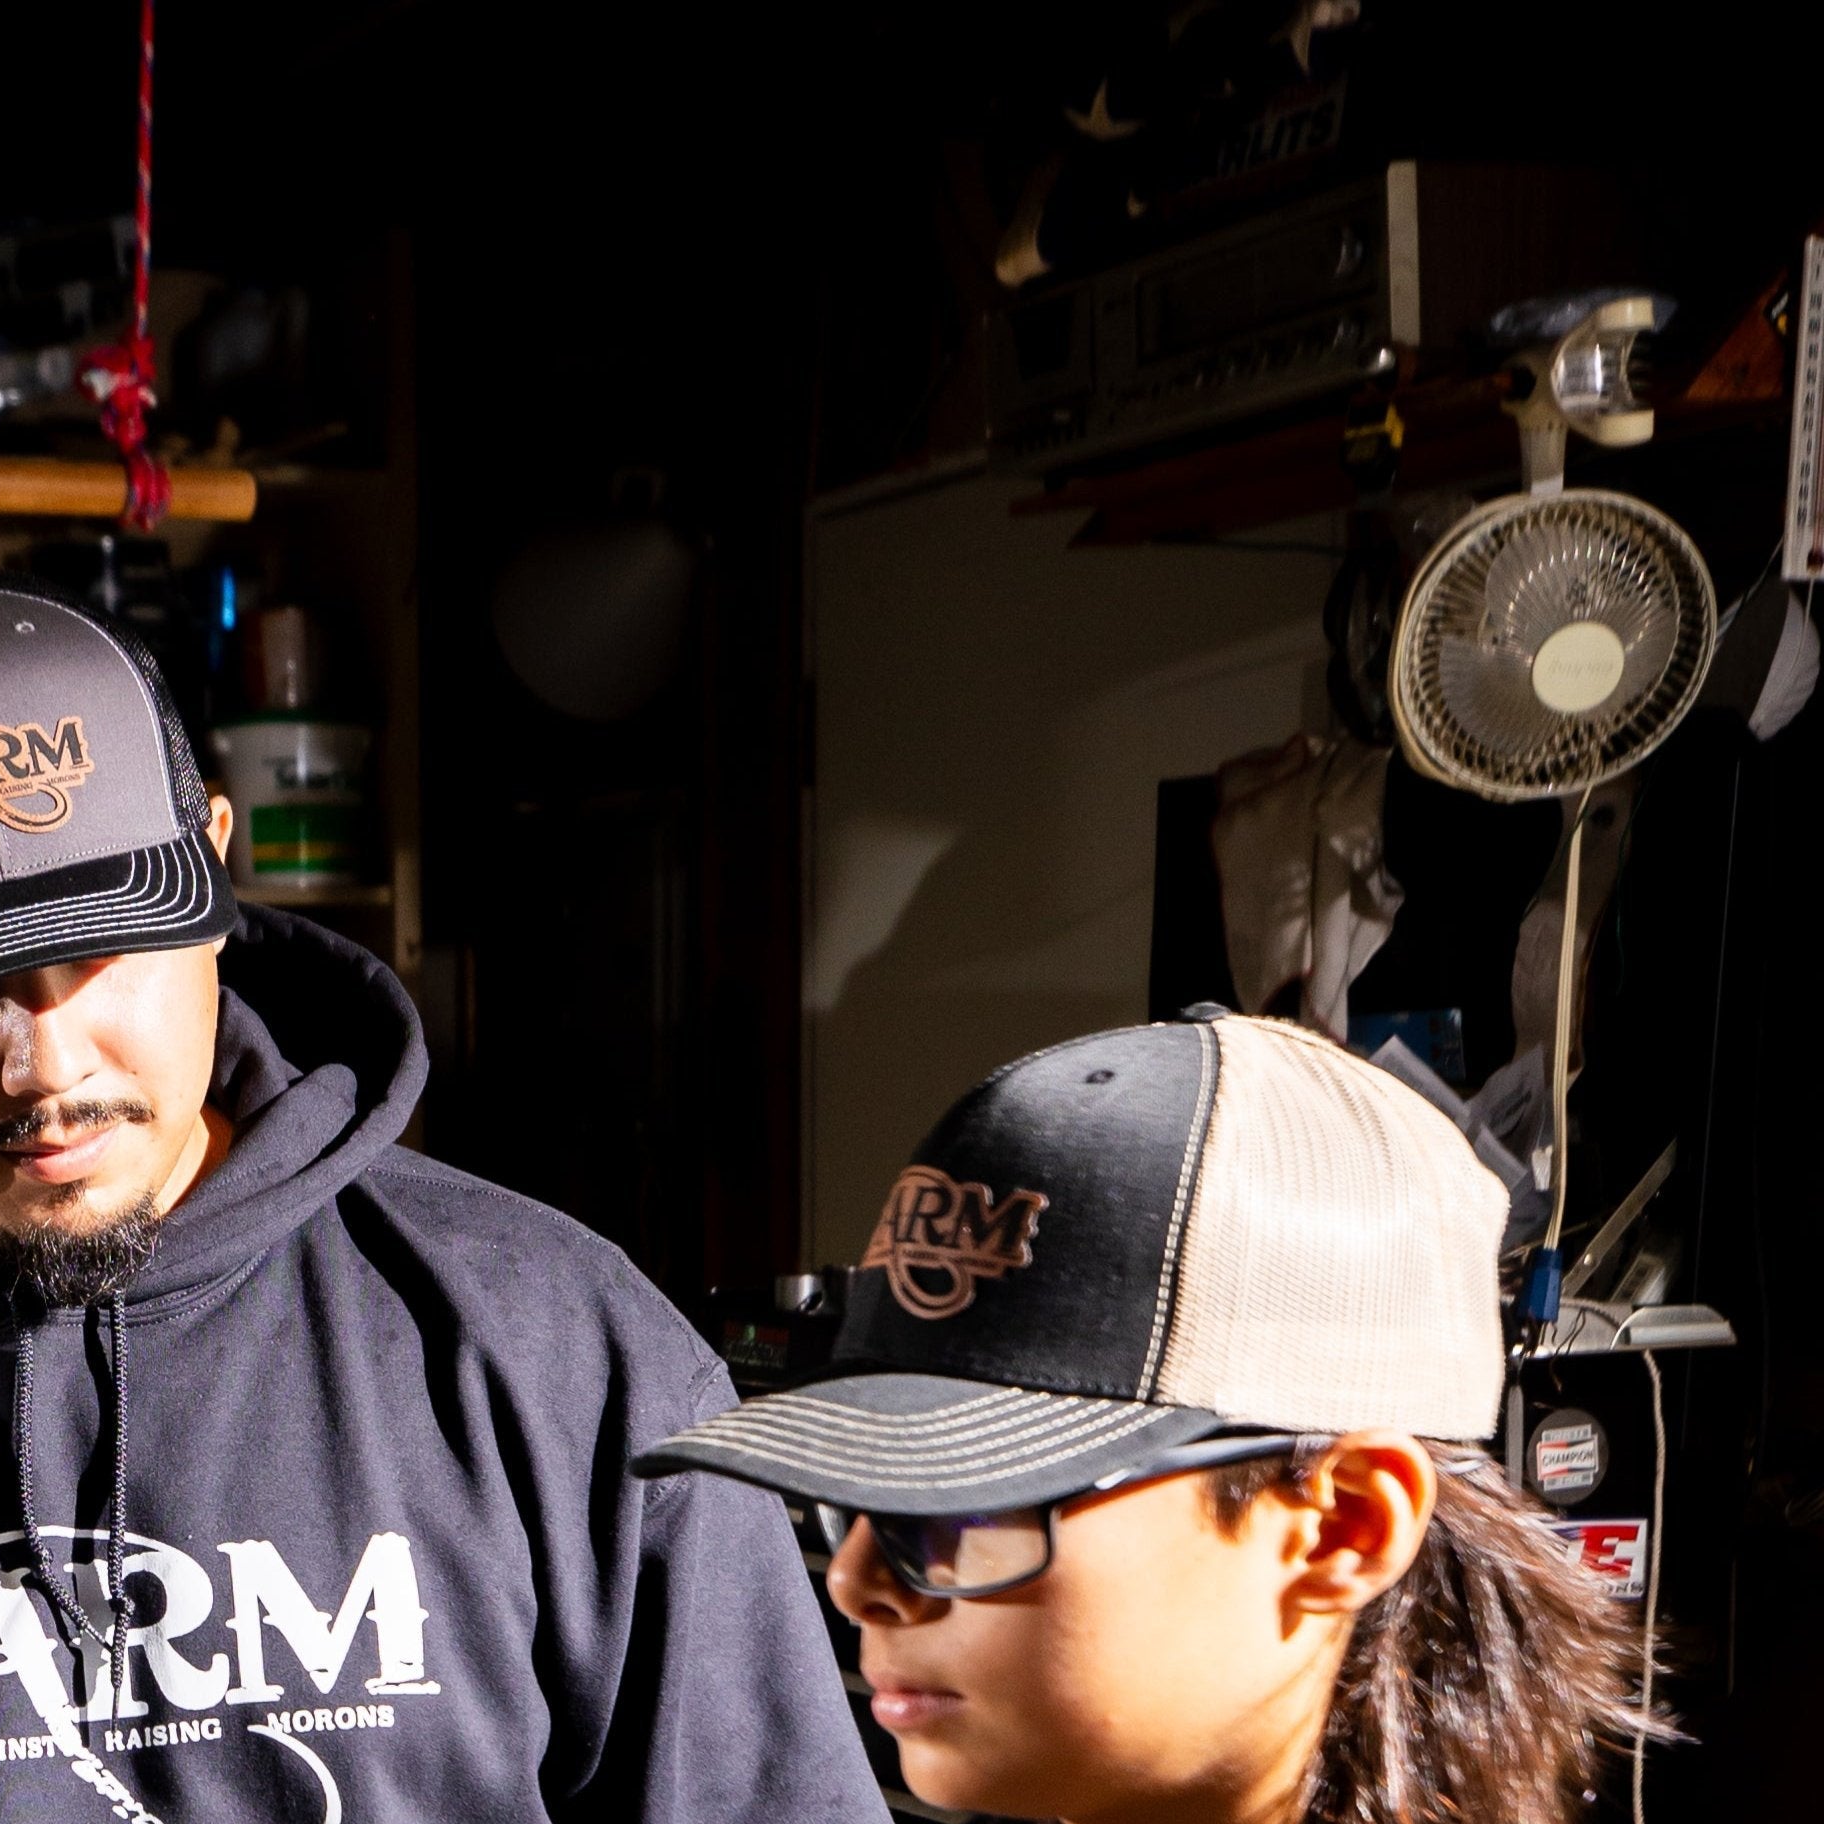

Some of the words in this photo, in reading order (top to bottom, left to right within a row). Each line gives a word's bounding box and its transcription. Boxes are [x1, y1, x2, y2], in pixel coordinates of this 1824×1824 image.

[1542, 1449, 1594, 1467] CHAMPION
[104, 1717, 223, 1752] RAISING
[265, 1704, 395, 1735] MORONS
